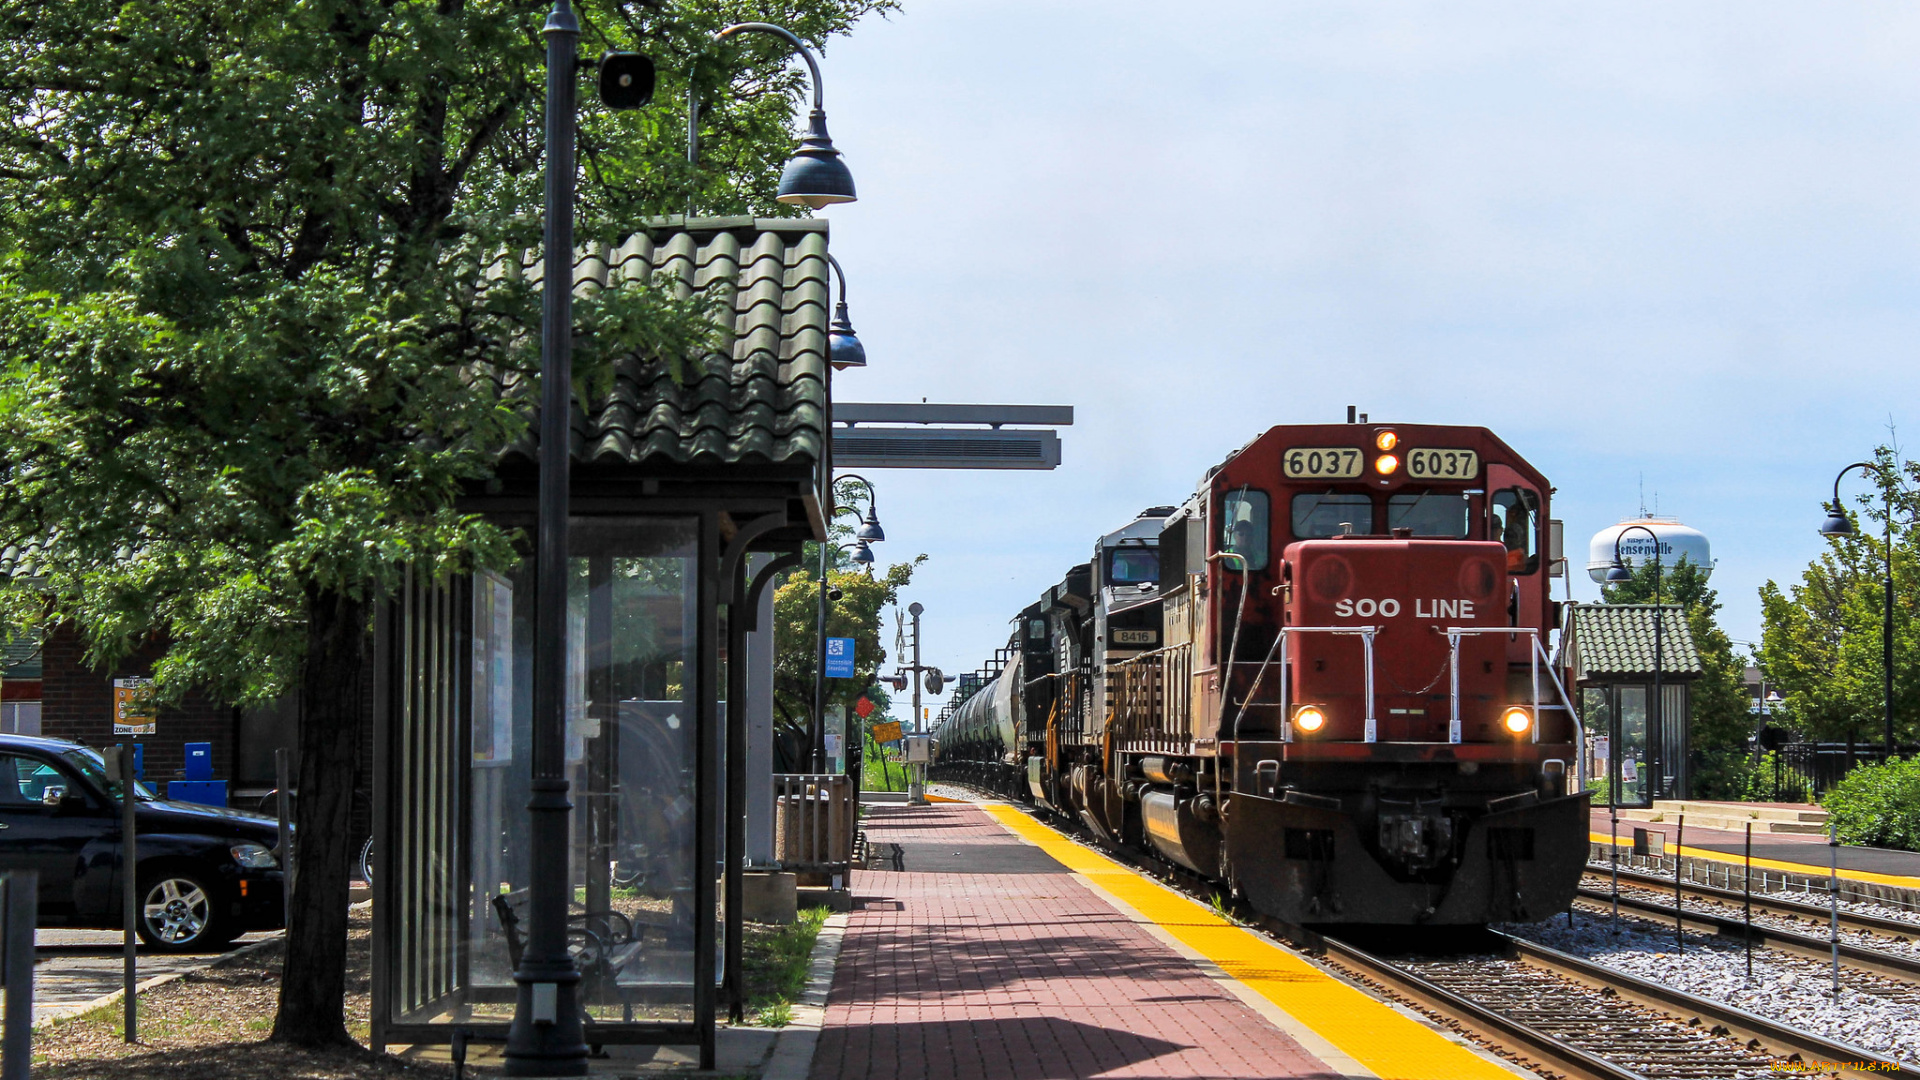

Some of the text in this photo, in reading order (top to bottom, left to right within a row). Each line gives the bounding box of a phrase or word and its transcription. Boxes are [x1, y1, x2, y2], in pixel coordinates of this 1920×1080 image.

[1289, 451, 1358, 475] 6037
[1412, 451, 1473, 476] 6037
[1615, 542, 1673, 555] ensenvlle
[1334, 598, 1475, 618] SOO LINE
[1121, 631, 1149, 641] 8416
